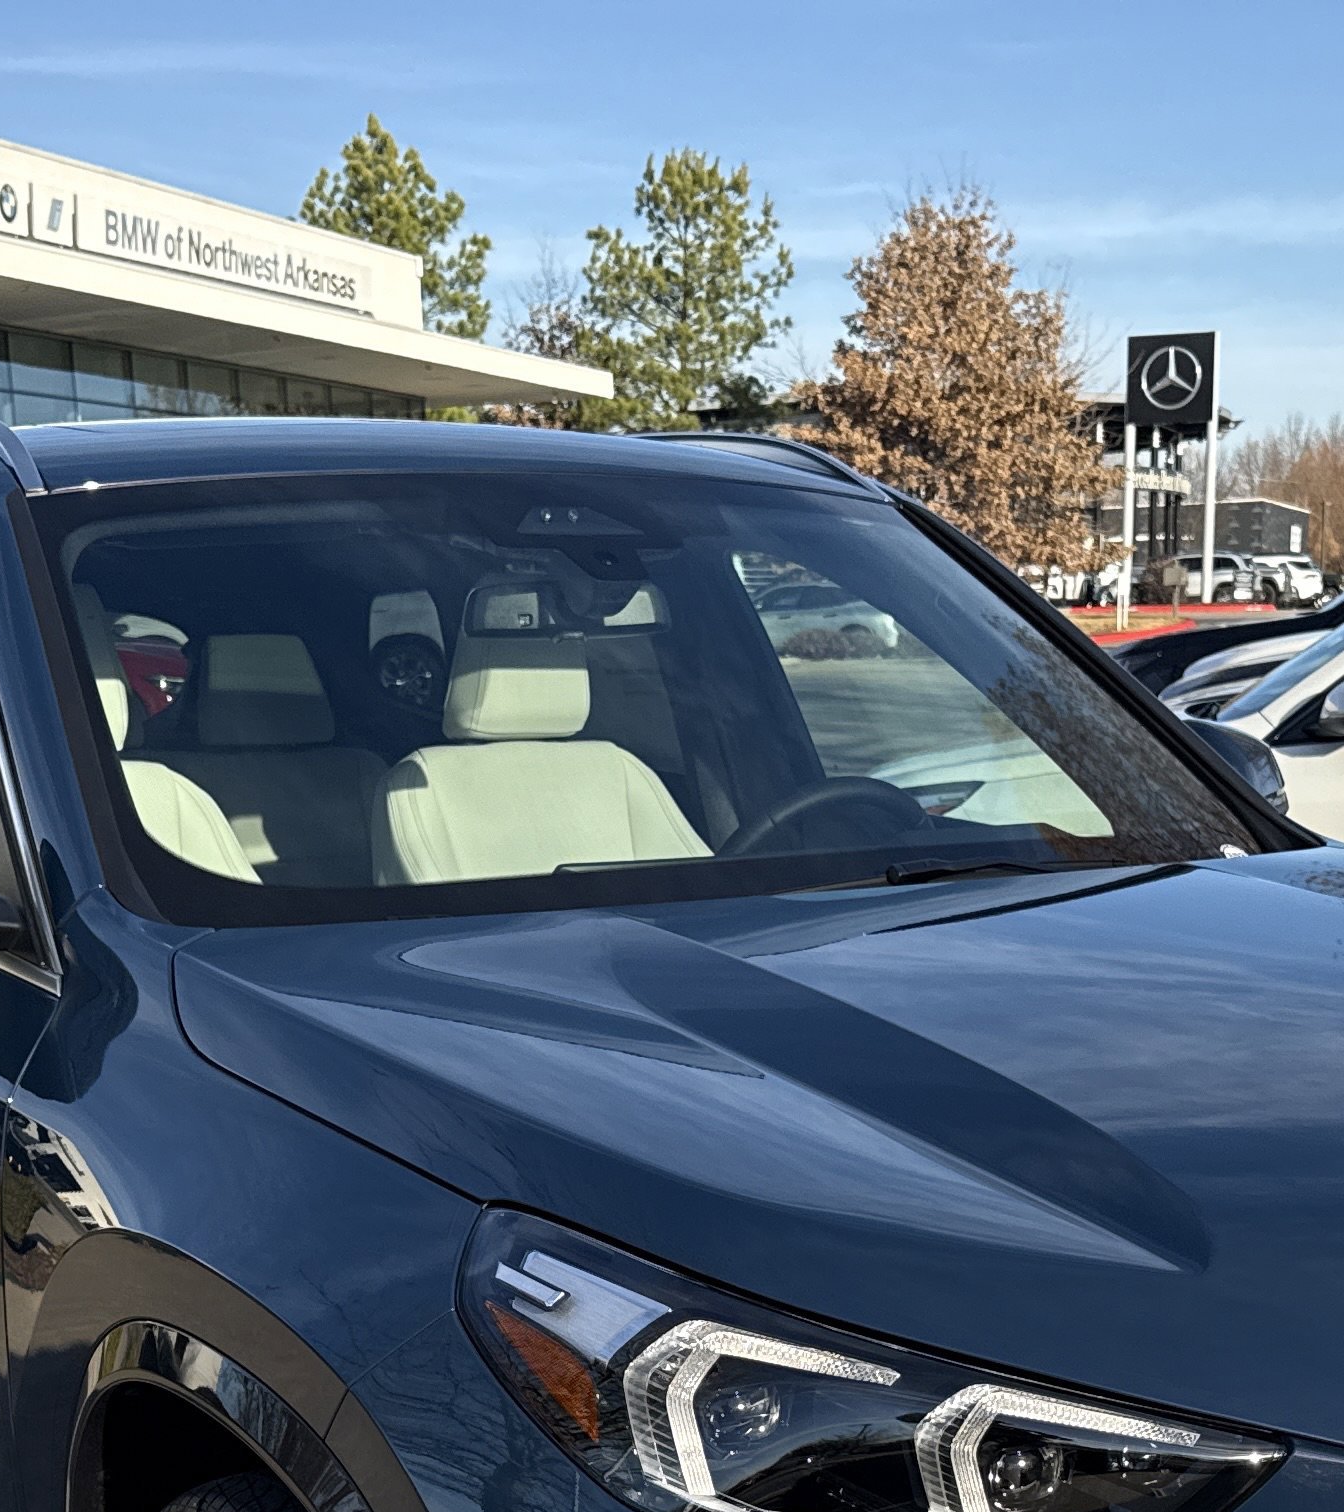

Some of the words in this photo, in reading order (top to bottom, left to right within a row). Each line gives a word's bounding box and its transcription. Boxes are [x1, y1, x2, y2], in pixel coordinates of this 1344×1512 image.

[105, 209, 160, 256] BMW
[164, 227, 184, 260] of
[188, 229, 281, 284] Northwest
[283, 253, 356, 301] Arkansas
